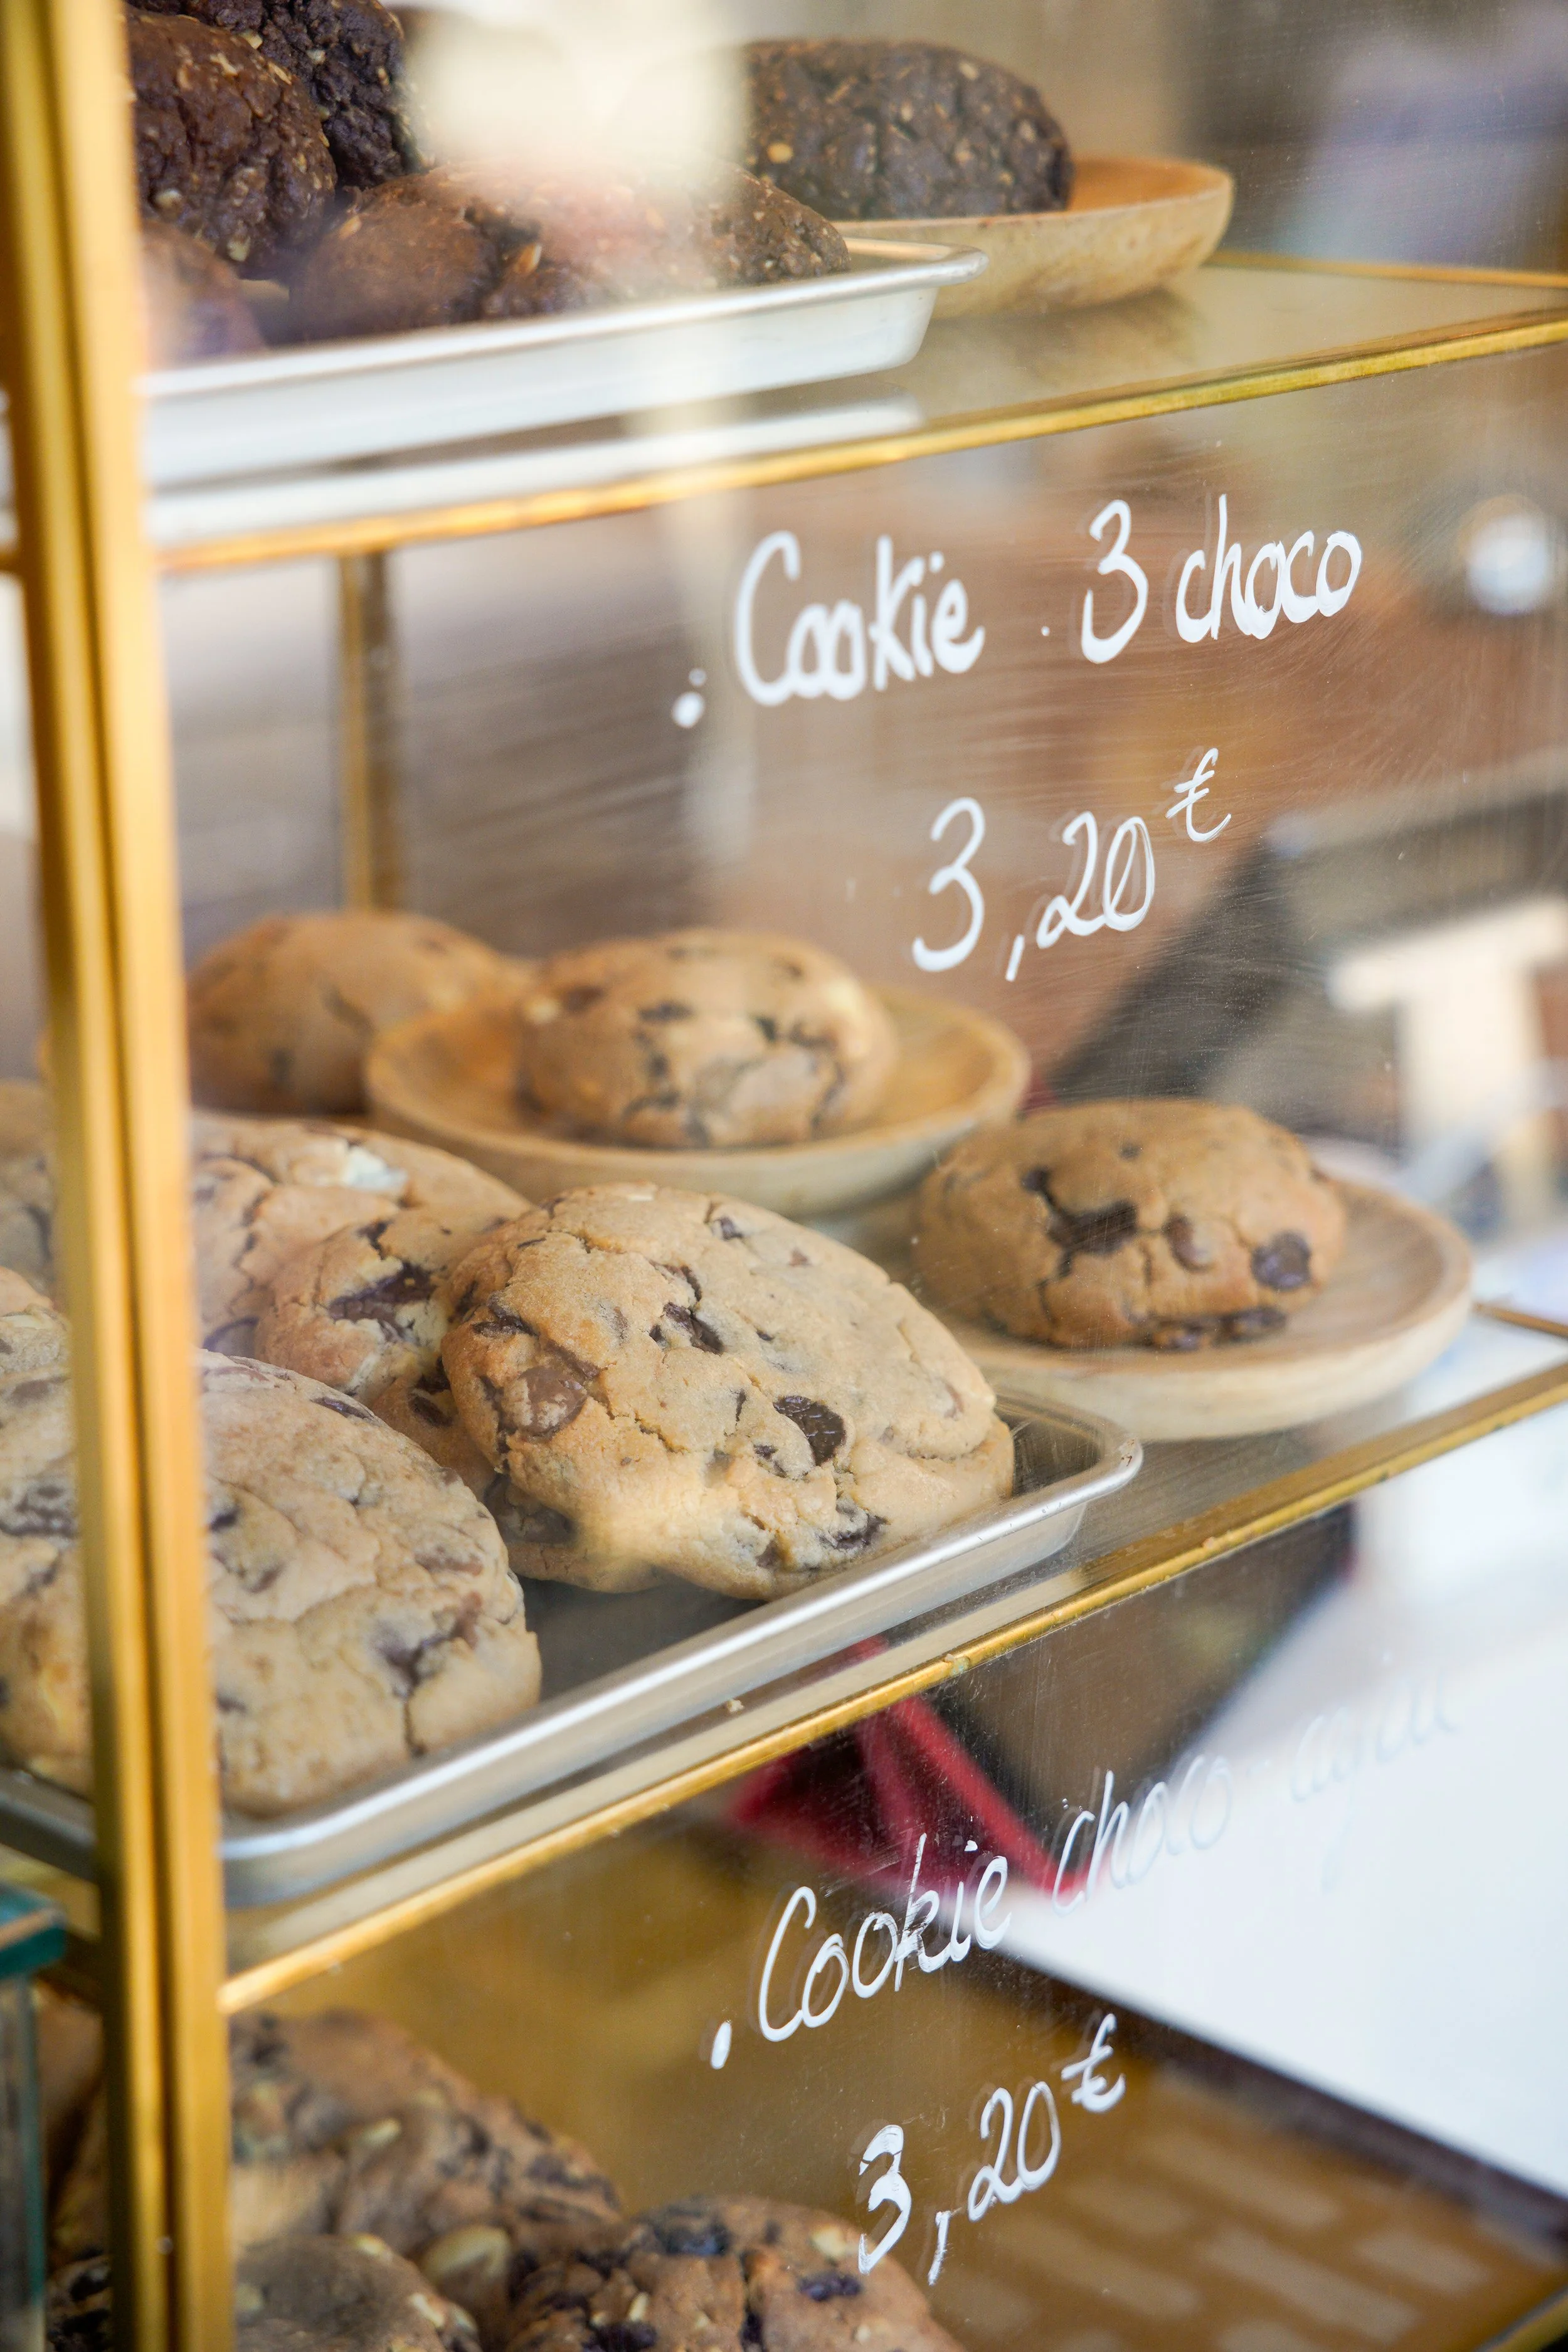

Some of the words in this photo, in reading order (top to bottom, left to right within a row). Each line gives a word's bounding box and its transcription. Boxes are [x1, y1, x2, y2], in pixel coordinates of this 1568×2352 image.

[1081, 499, 1150, 665] 3
[1174, 494, 1362, 644] choco
[758, 1832, 1012, 2042] Cookie
[1051, 1754, 1233, 1917] choco
